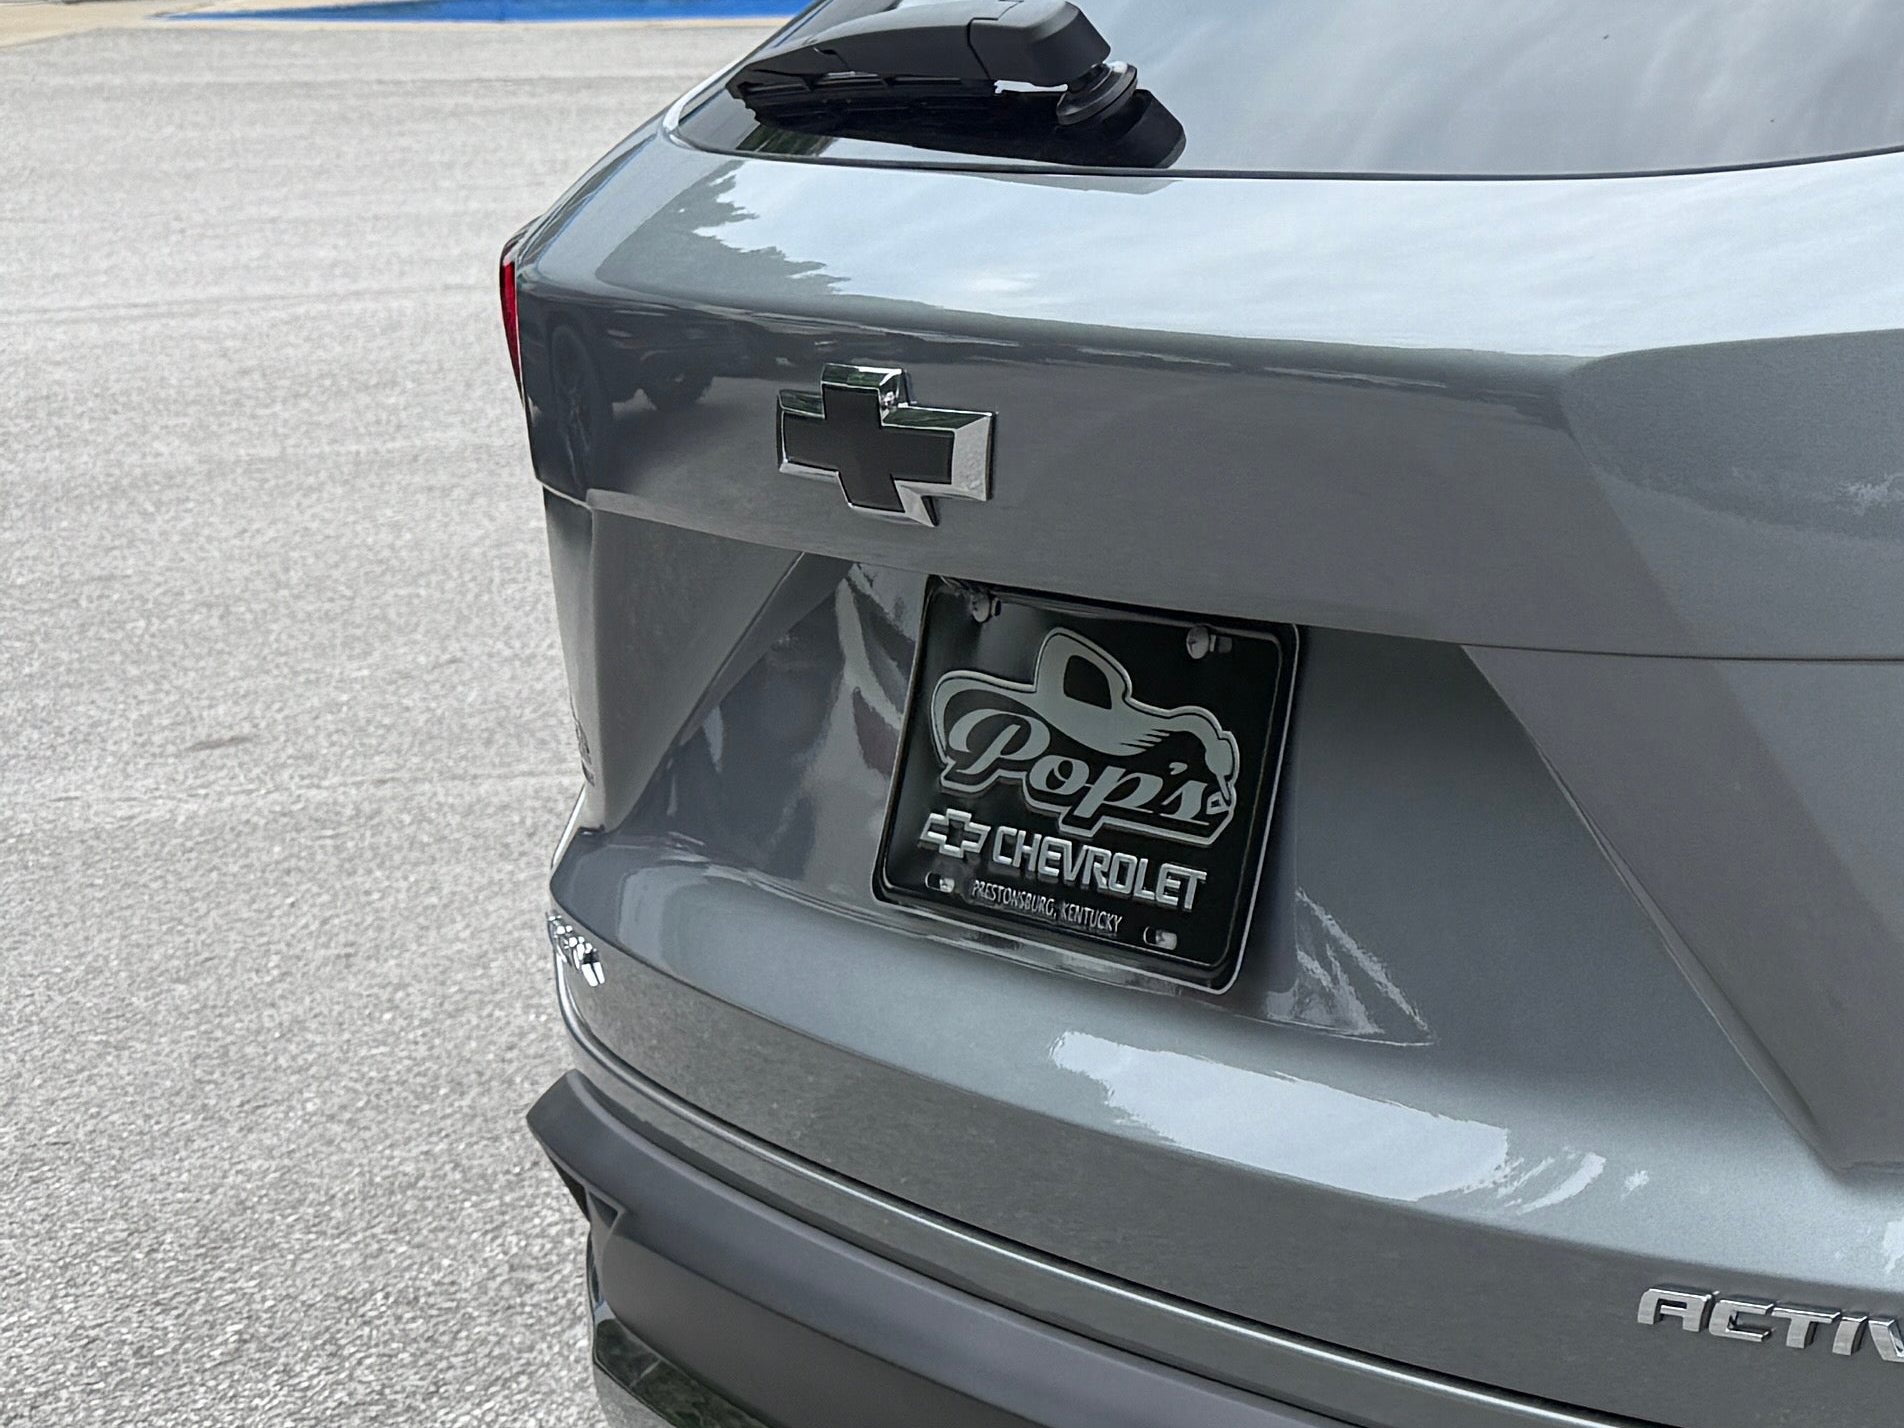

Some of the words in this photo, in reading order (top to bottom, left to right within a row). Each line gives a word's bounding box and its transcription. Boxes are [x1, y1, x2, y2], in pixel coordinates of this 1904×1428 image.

[948, 708, 1211, 827] Pop's
[992, 826, 1208, 911] CHEVROLET
[1060, 901, 1123, 932] KENTUCKY
